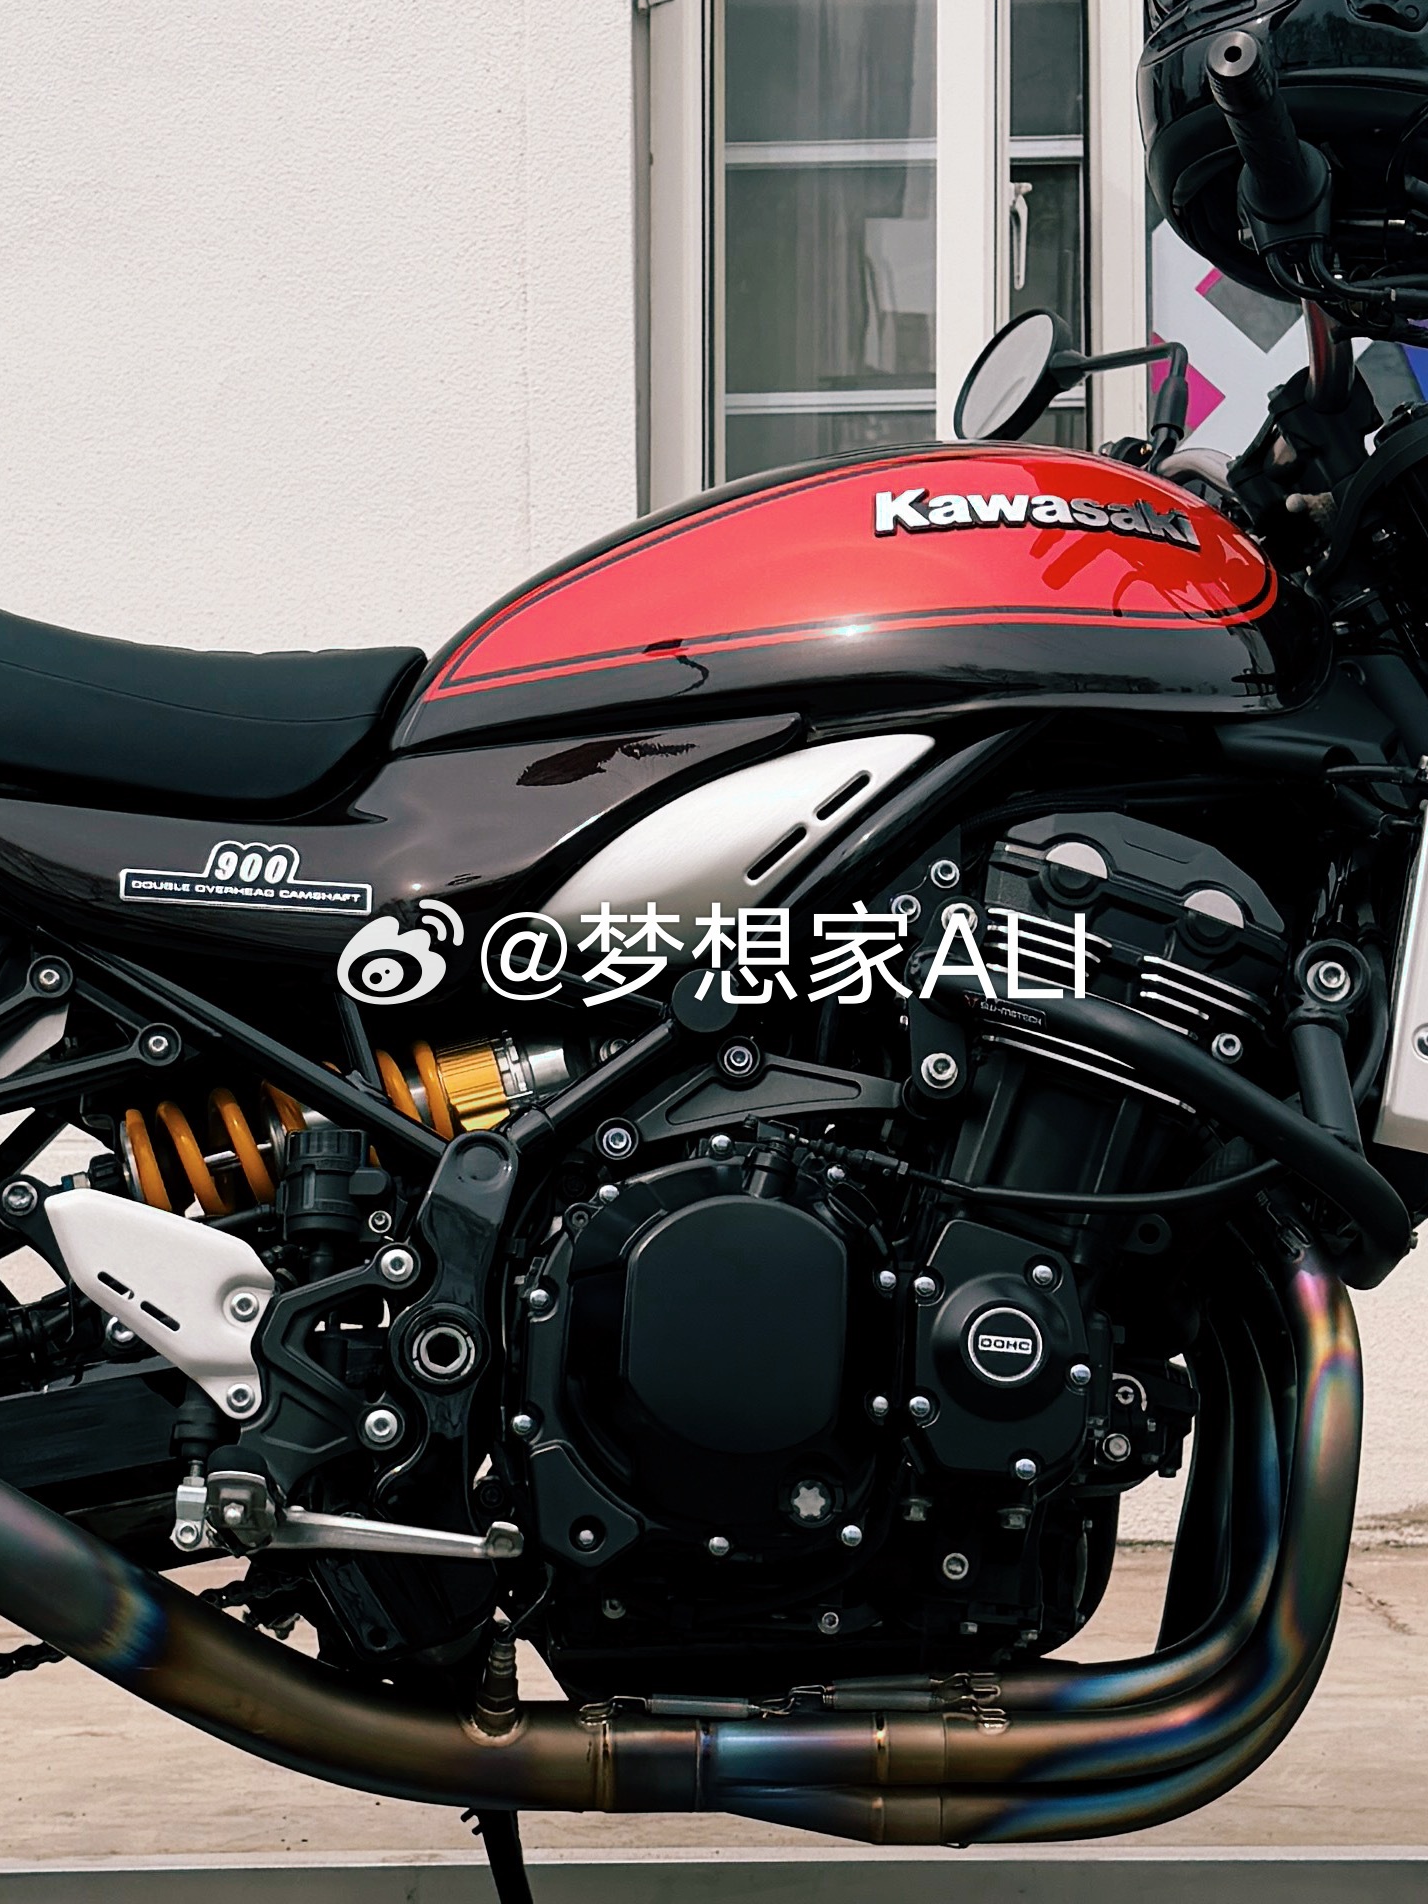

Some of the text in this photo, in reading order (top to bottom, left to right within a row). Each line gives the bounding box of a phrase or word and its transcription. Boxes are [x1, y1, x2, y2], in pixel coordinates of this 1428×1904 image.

[874, 487, 1202, 553] Kawasaki
[215, 850, 289, 884] 900
[131, 879, 362, 904] DOUBLE OVERHEAD CAMSHAFT
[979, 1336, 1031, 1352] DOHC
